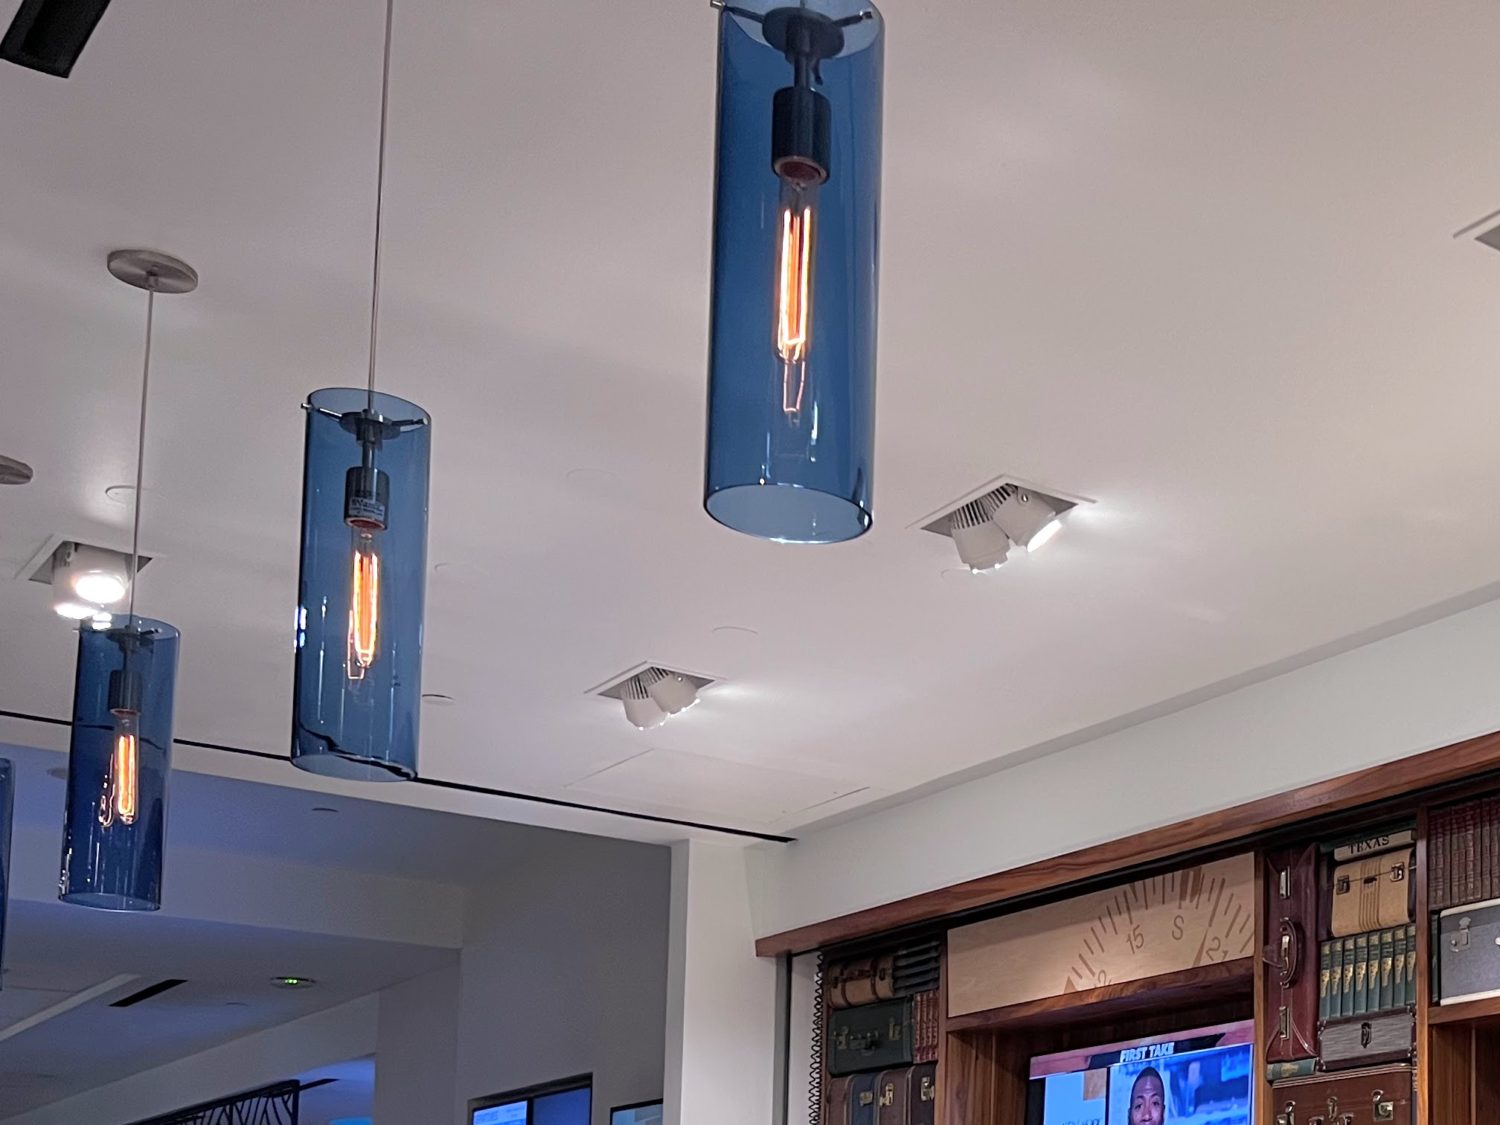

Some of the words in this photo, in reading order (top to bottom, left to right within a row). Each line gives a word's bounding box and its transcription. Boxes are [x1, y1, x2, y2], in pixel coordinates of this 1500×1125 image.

[1347, 834, 1390, 855] TEXAS
[1171, 914, 1185, 941] S
[1119, 1045, 1148, 1063] FIRST
[1149, 1042, 1175, 1059] TAKE
